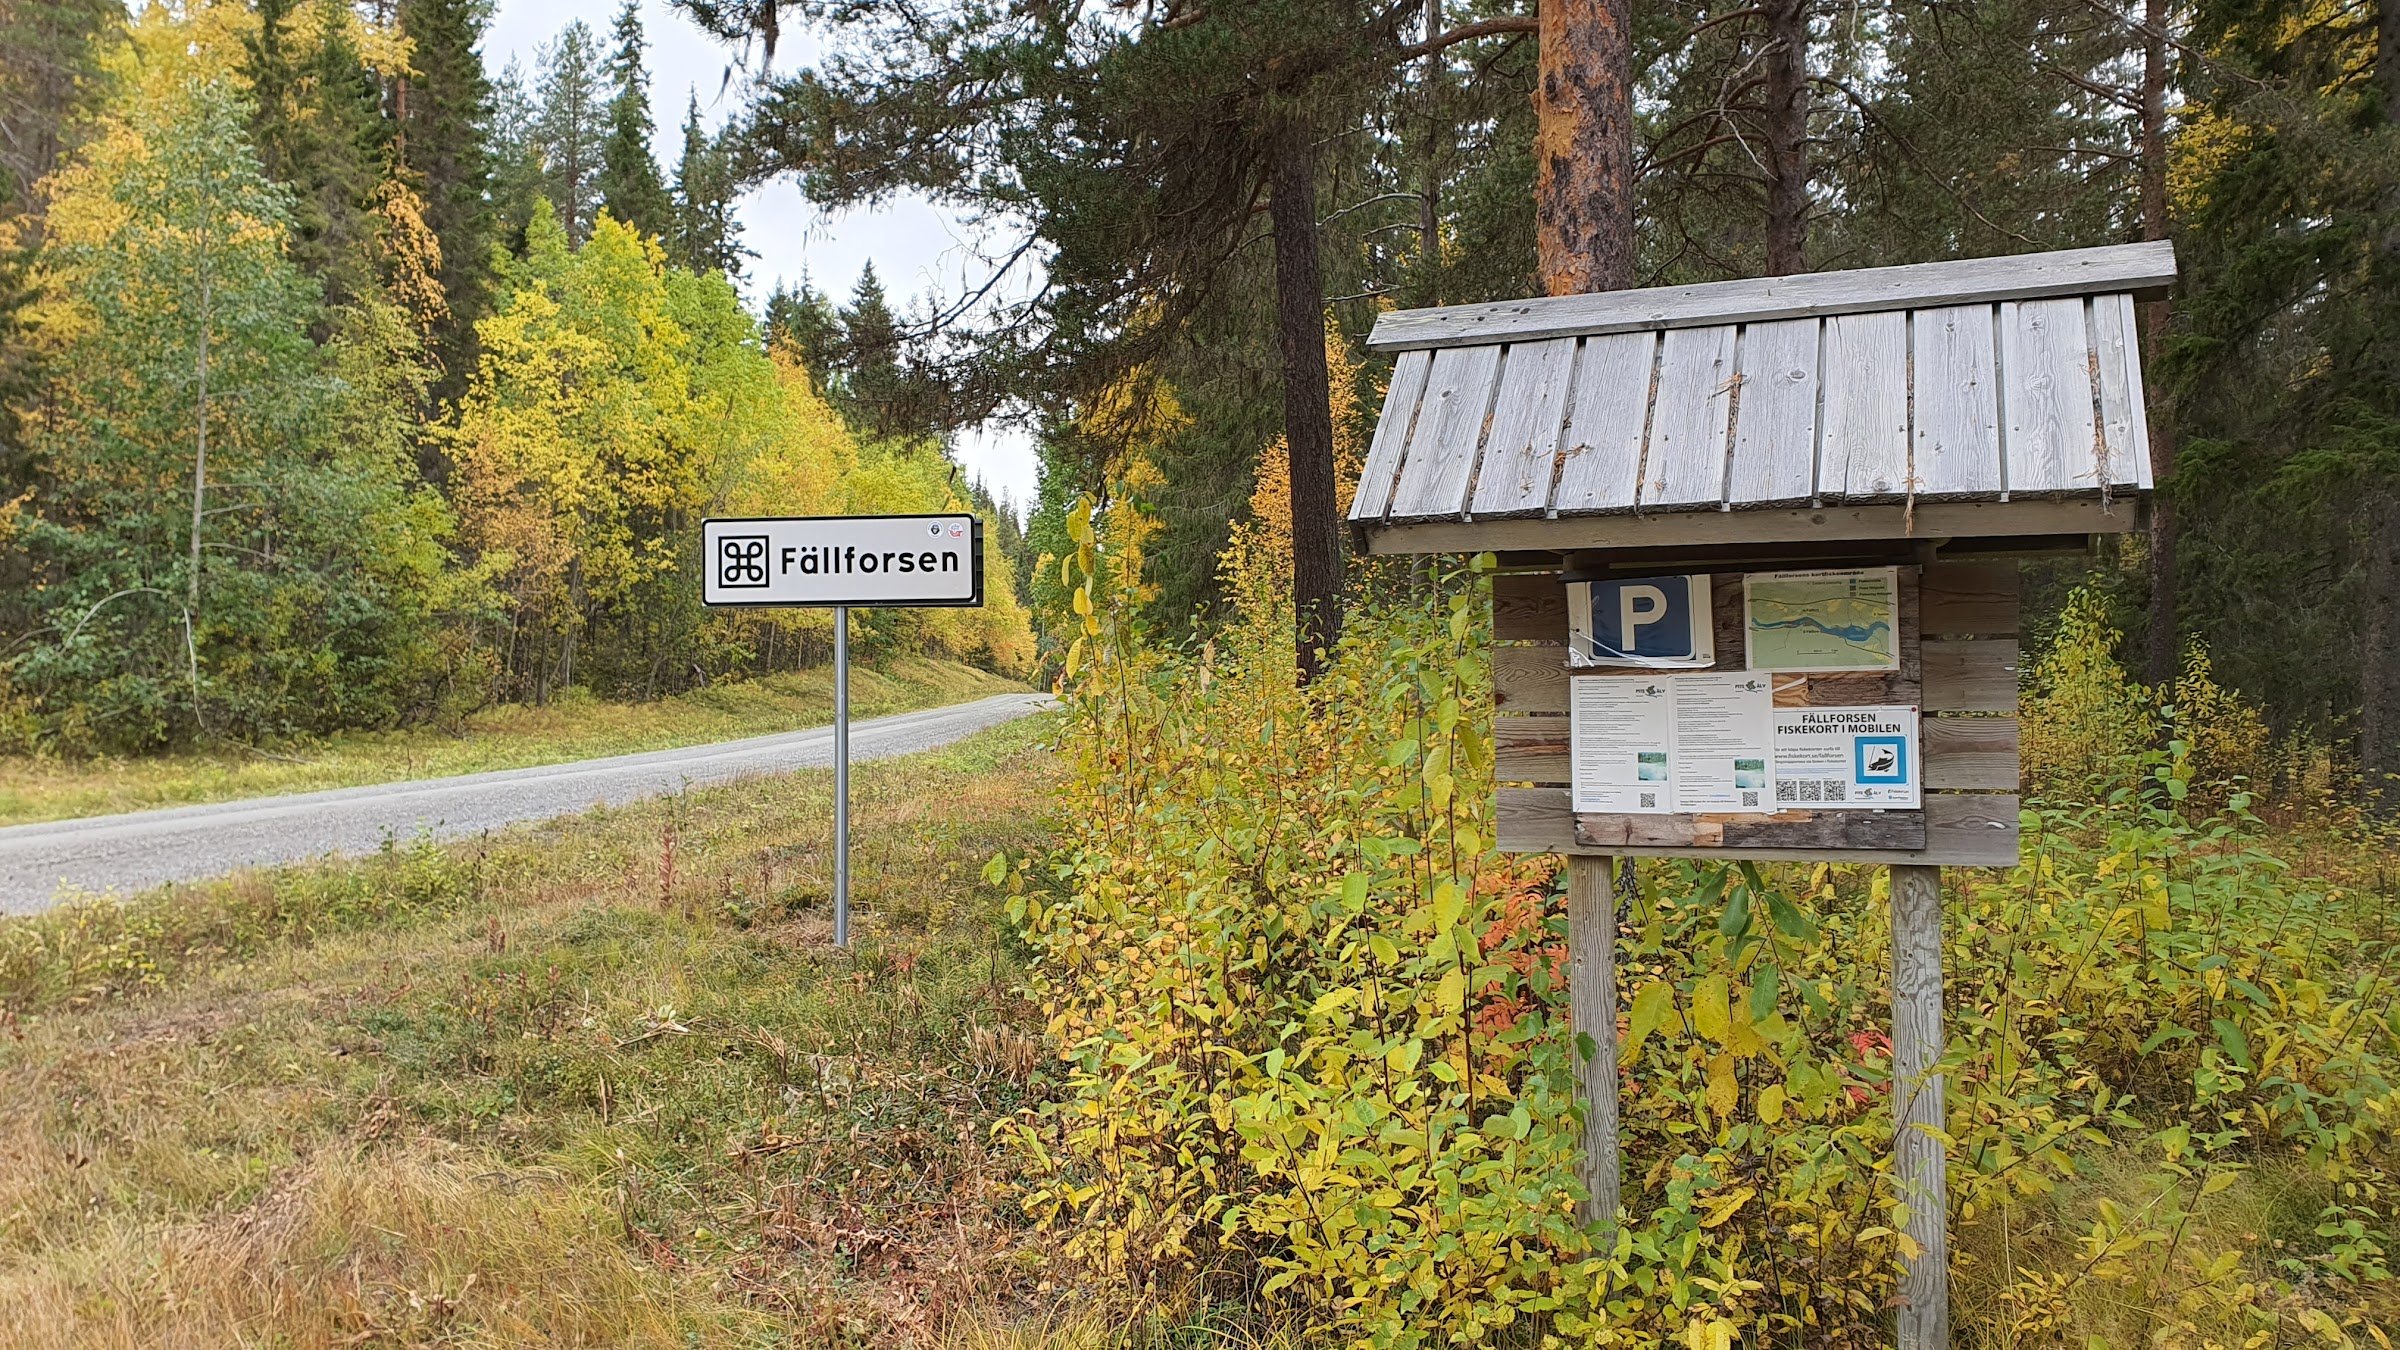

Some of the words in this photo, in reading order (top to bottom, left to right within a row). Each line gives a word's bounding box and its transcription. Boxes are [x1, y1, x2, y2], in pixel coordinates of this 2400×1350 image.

[781, 546, 959, 575] Fällforsen
[1620, 585, 1667, 651] P
[1802, 713, 1876, 724] FÄLLFORSEN
[1777, 724, 1839, 735] FISKEKORT
[1842, 725, 1845, 733] I
[1848, 724, 1901, 733] MOBILEN
